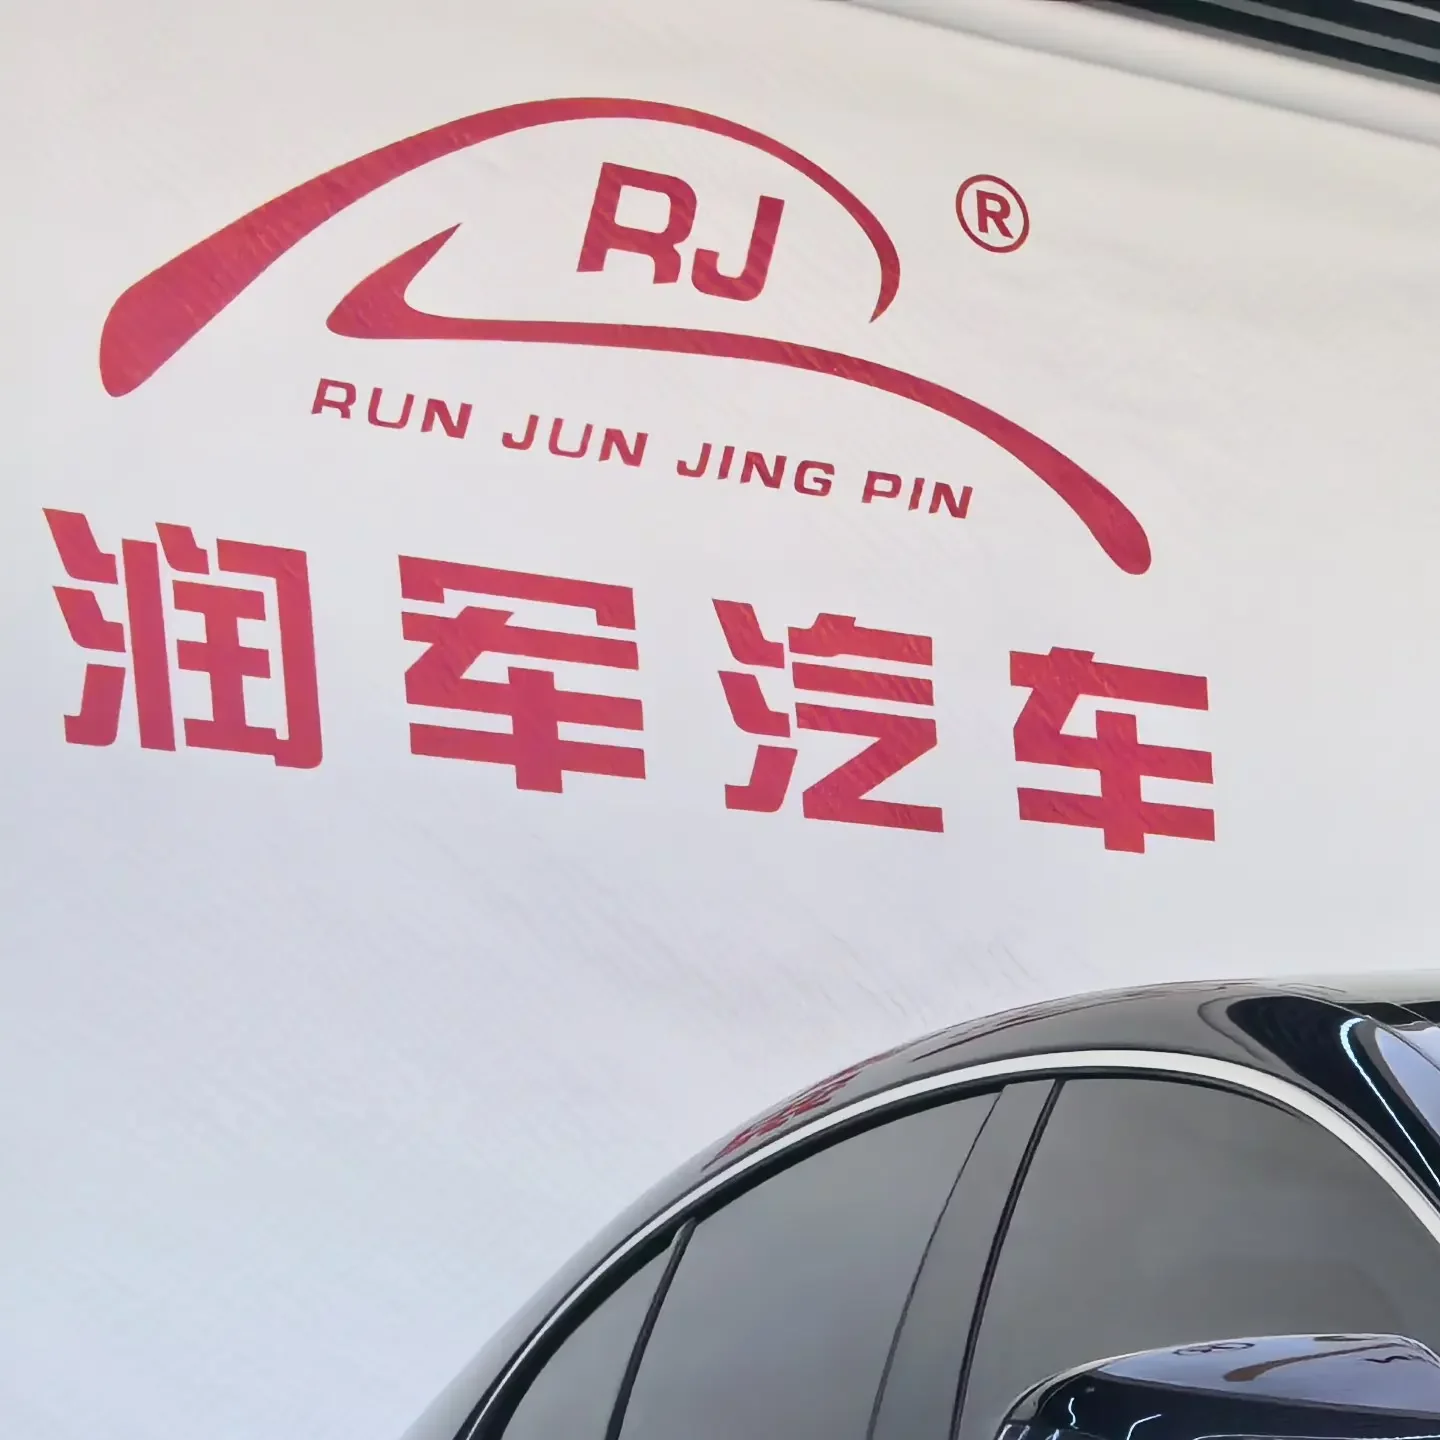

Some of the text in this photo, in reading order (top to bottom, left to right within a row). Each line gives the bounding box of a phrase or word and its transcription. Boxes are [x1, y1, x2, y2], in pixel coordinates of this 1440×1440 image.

[578, 162, 785, 301] RJ
[311, 378, 973, 520] RUN JUN JING PIN
[42, 507, 1216, 855] 润军汽车
